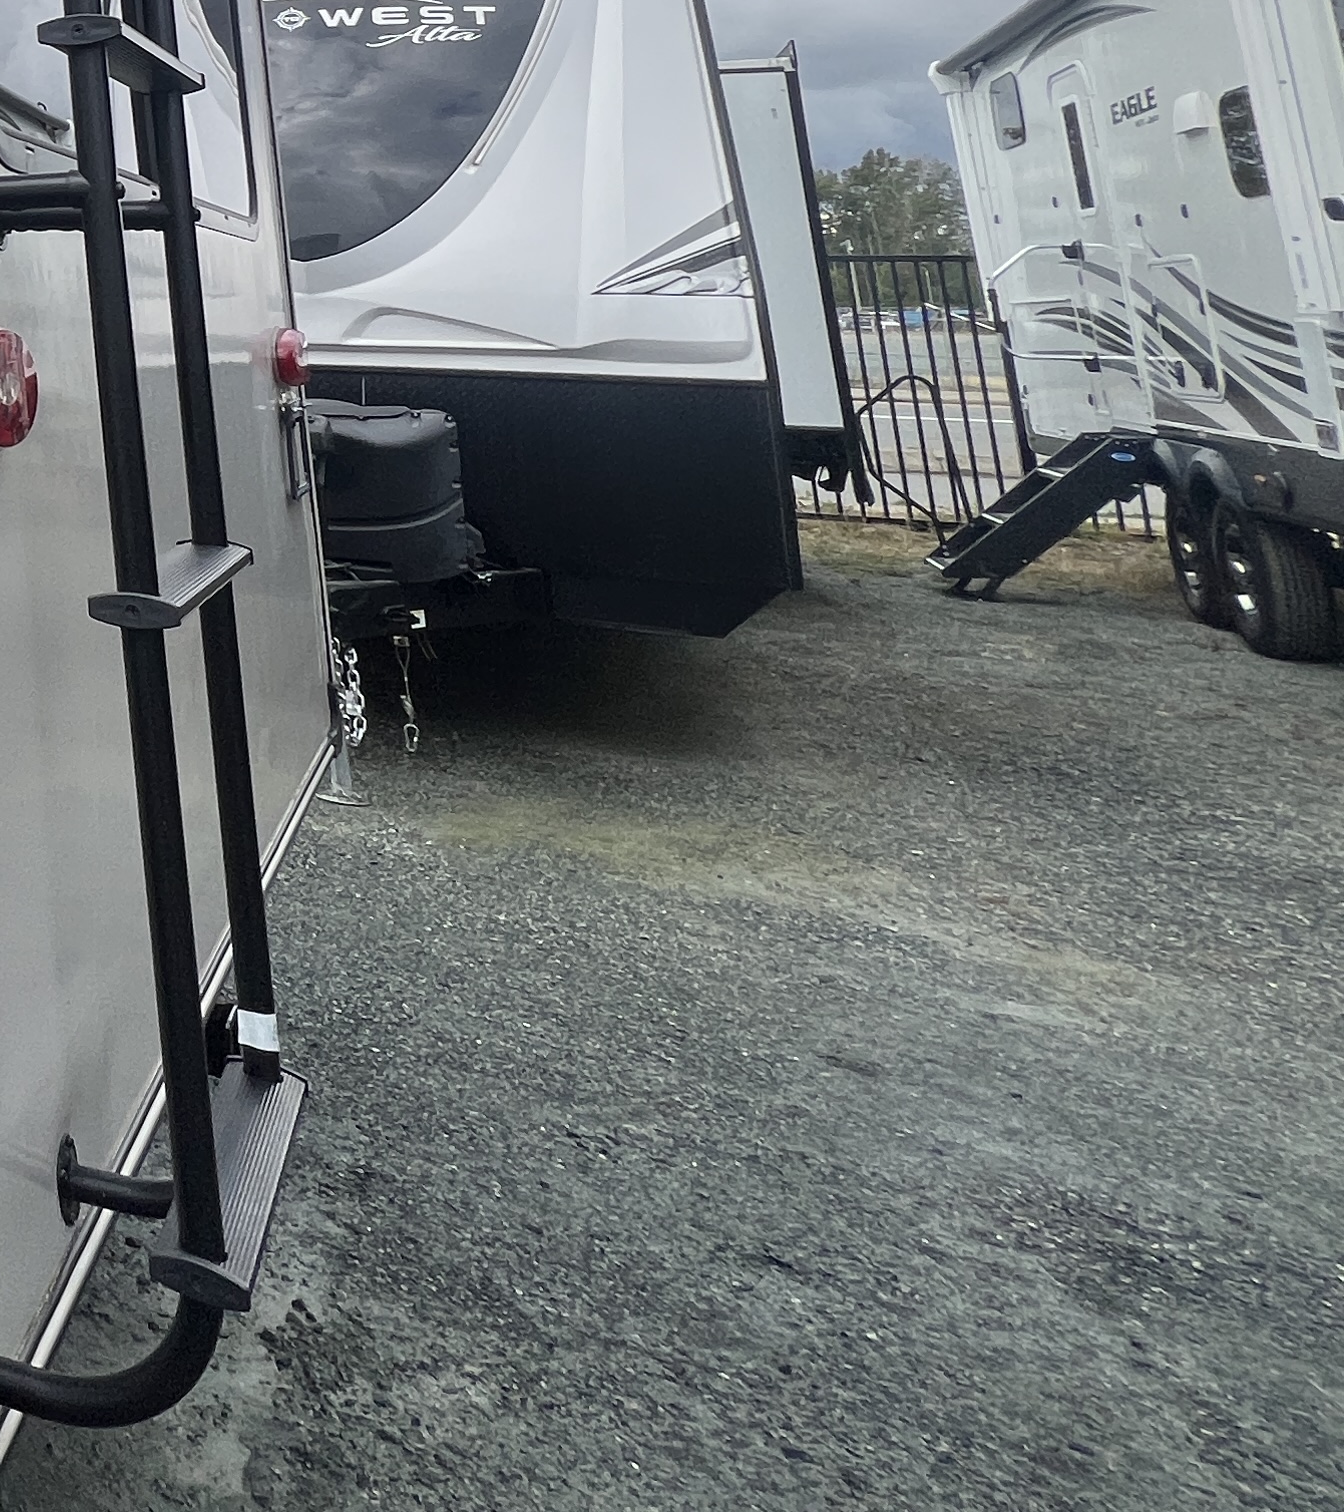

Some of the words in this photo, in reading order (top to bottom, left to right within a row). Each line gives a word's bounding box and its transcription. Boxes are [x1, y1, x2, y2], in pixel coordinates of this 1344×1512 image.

[317, 5, 497, 28] WEST
[365, 24, 483, 48] Alta
[1109, 85, 1158, 125] EAGLE
